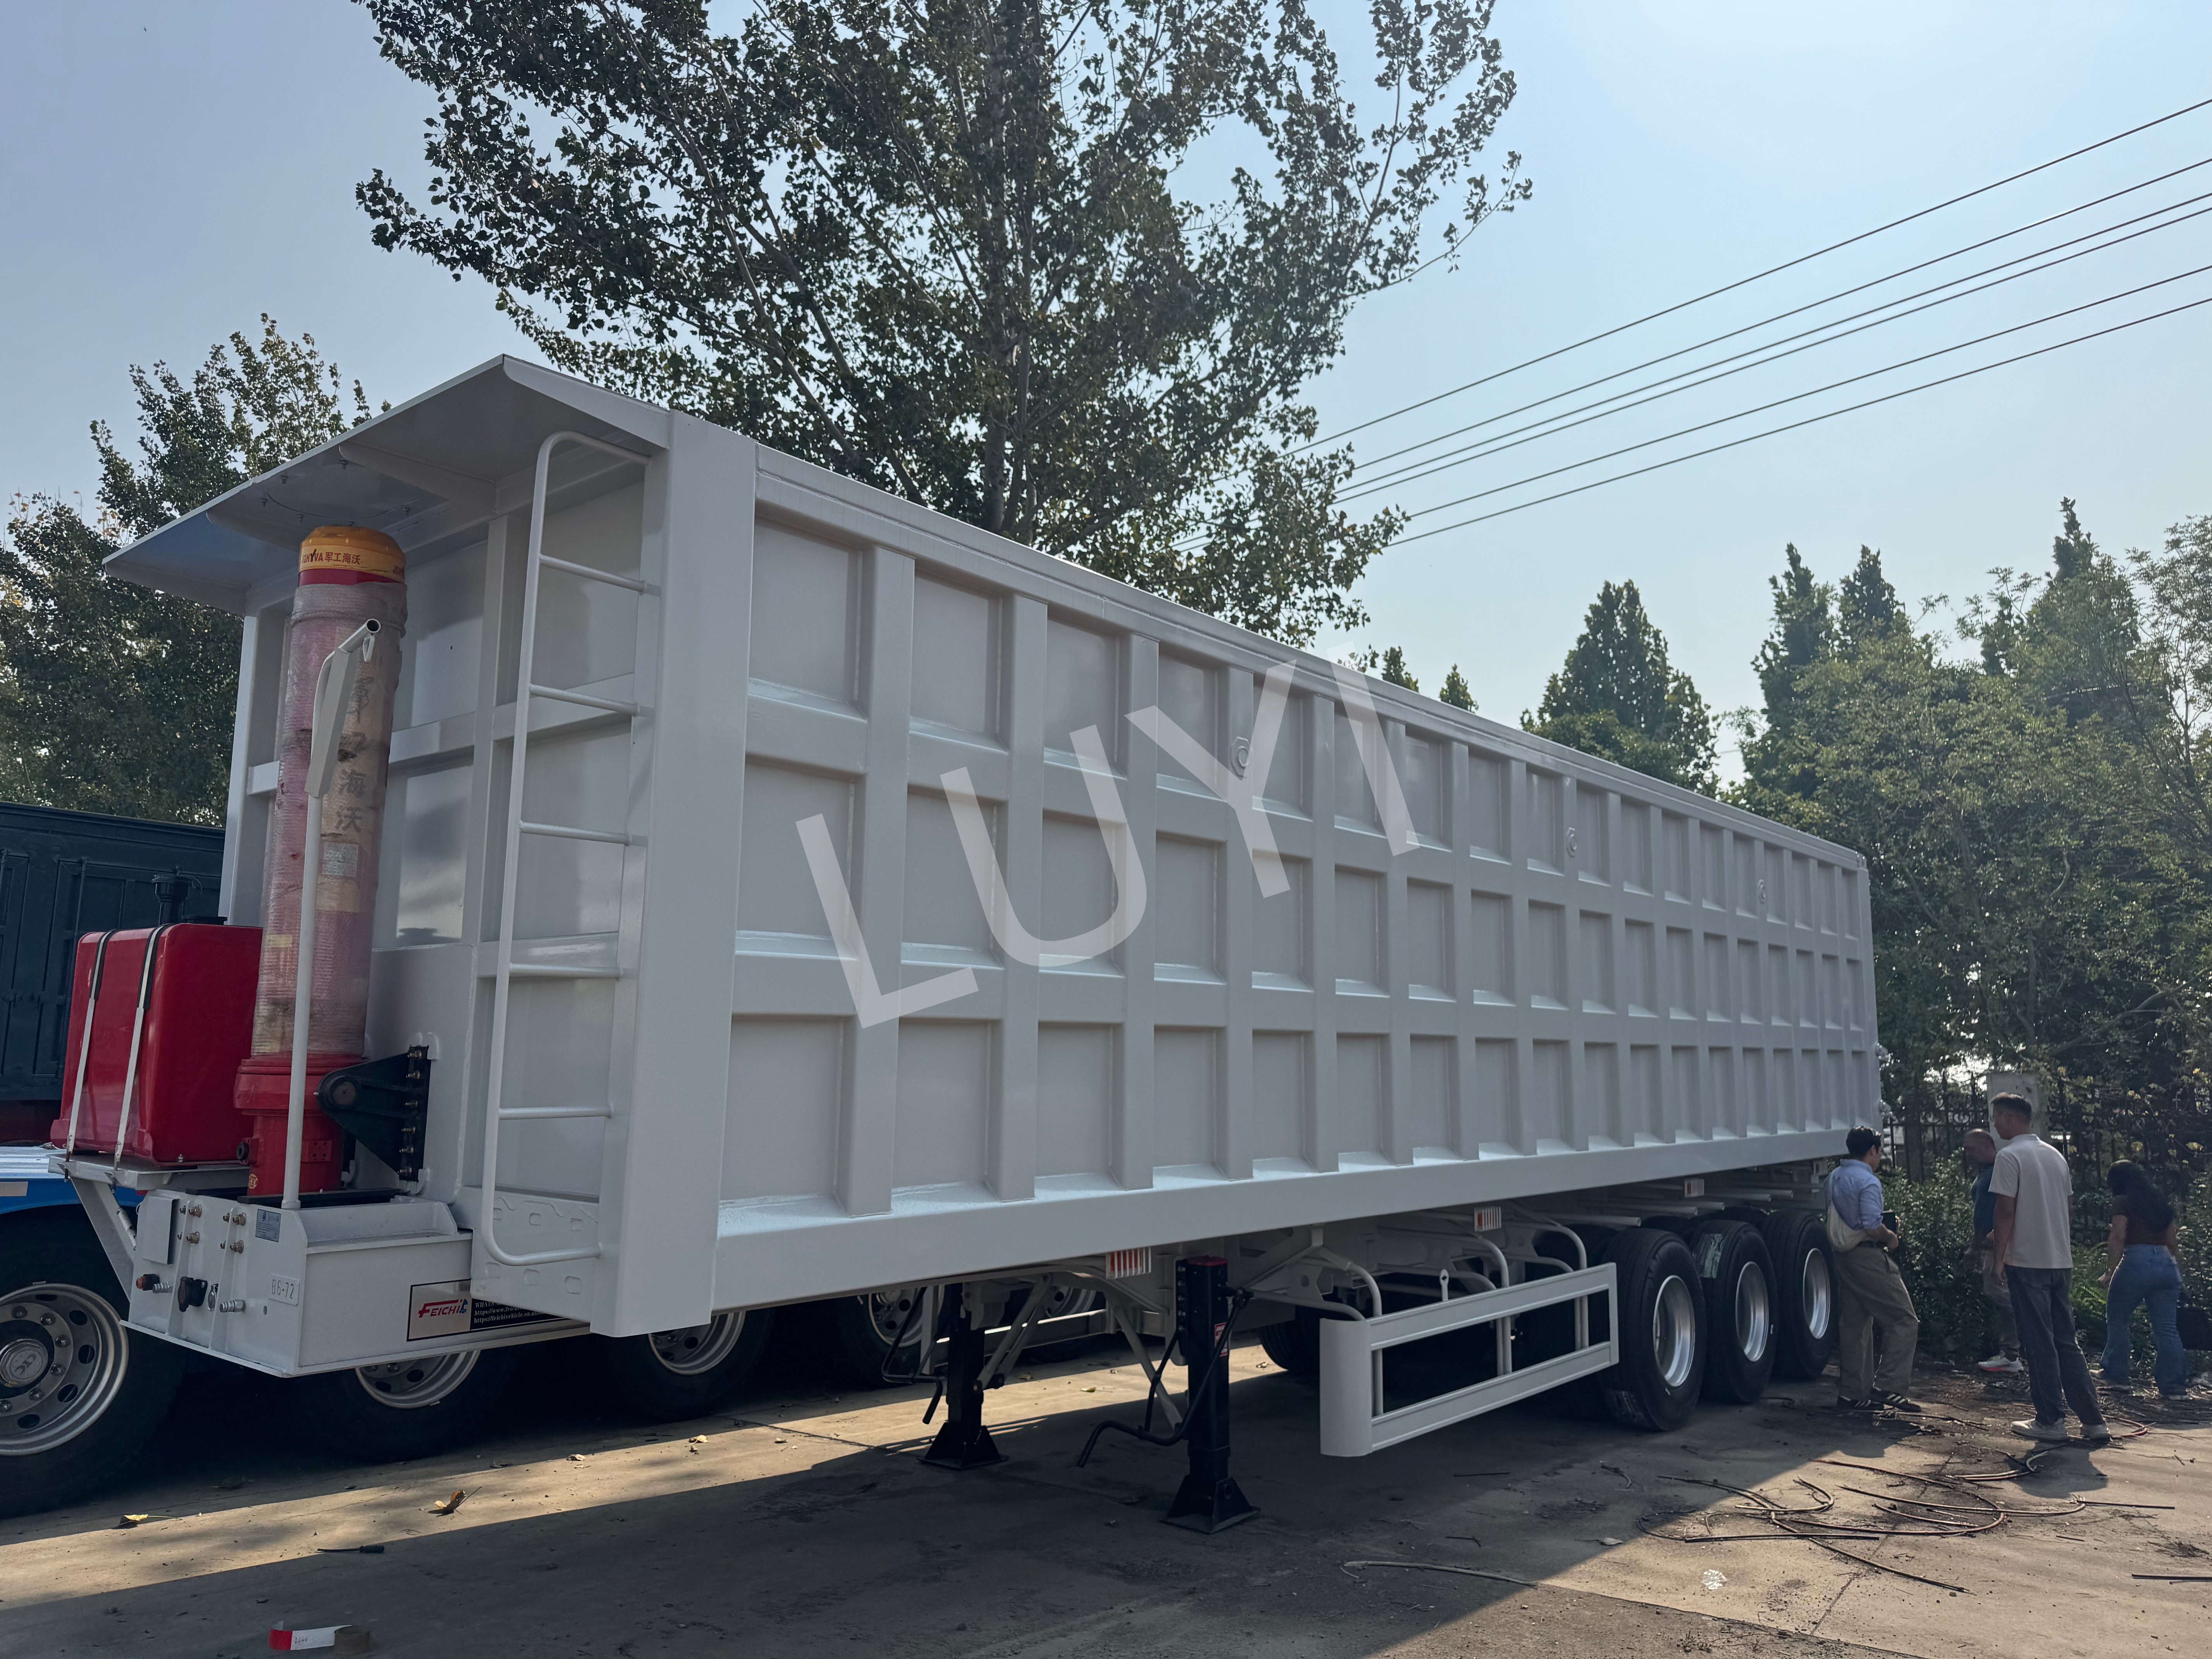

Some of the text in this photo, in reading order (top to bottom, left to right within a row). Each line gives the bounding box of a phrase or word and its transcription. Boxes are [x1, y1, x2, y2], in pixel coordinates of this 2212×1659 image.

[324, 552, 361, 565] 军工海沃
[418, 1299, 461, 1318] FEICHI
